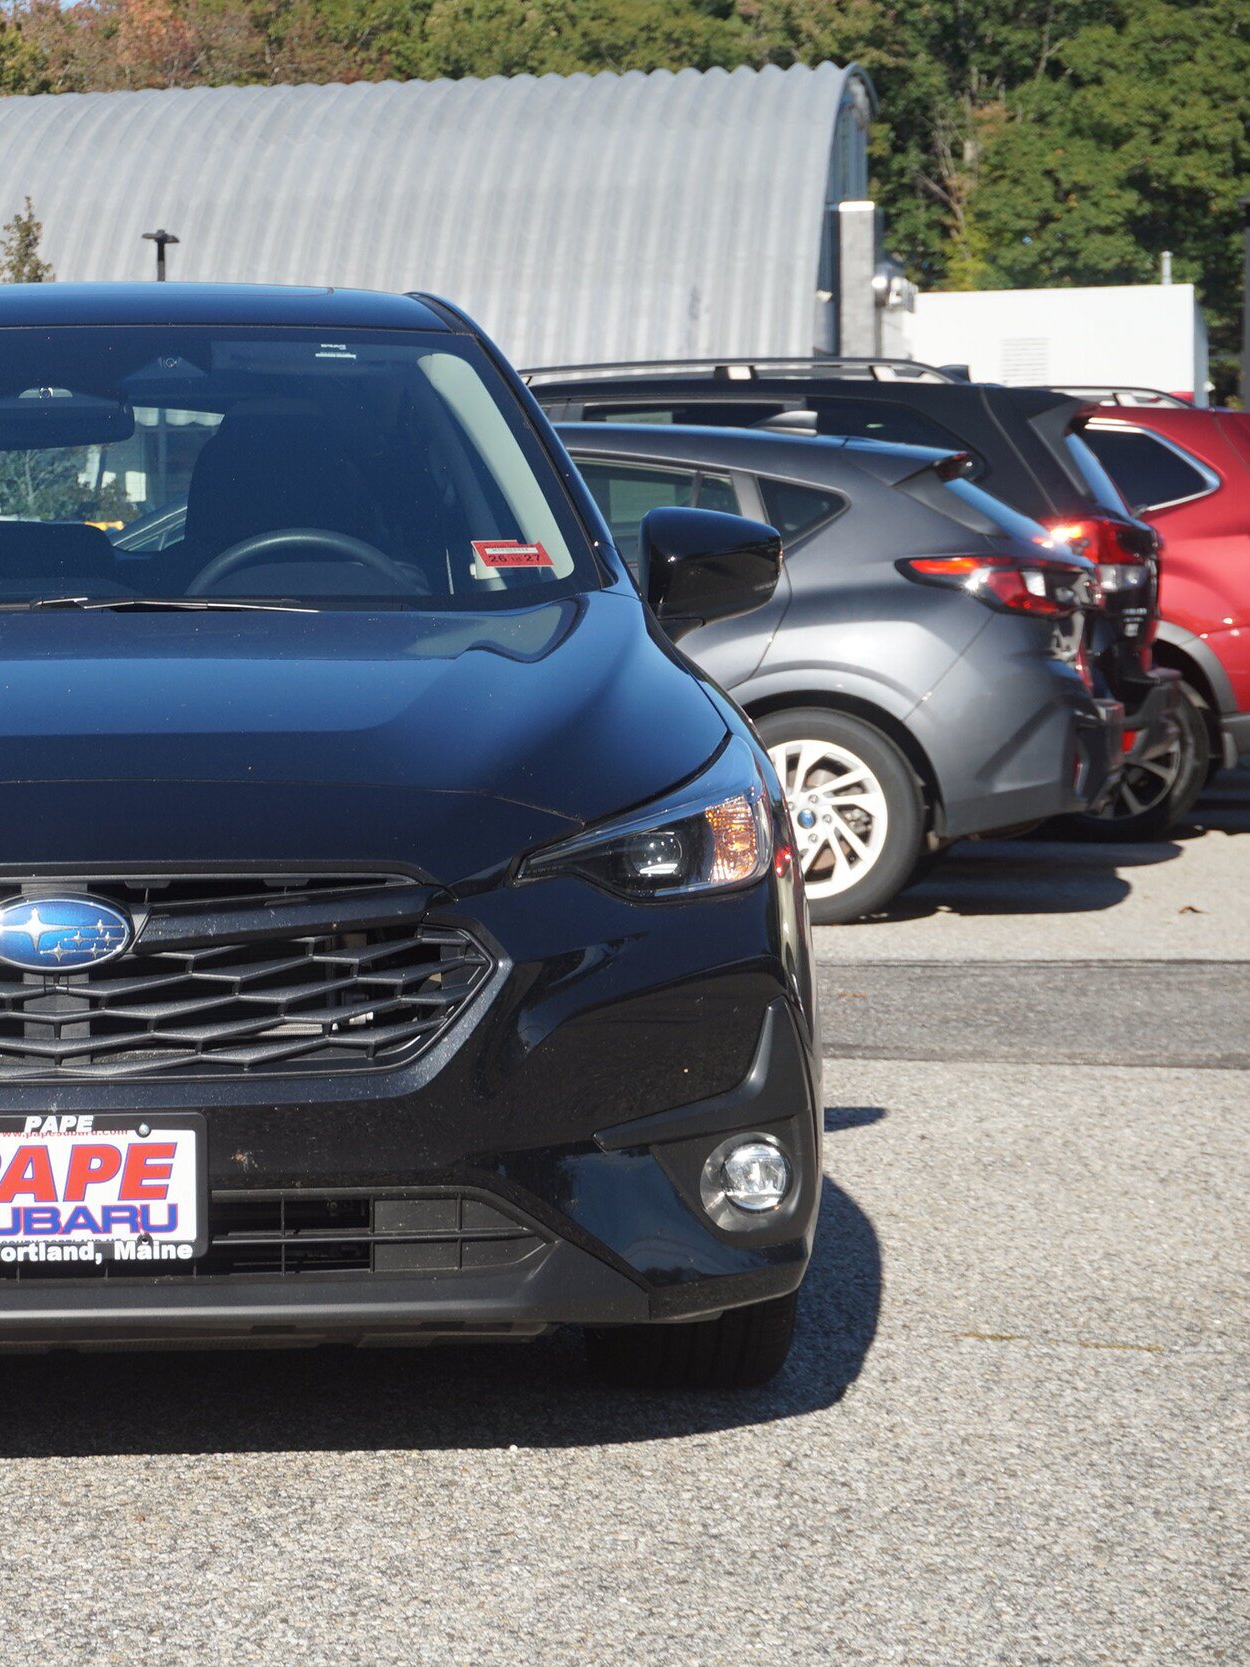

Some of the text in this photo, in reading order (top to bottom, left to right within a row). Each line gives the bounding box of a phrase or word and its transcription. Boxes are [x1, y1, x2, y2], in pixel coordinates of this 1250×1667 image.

[489, 554, 507, 562] 26
[524, 553, 540, 562] 27
[24, 1115, 94, 1133] PAPE
[114, 1237, 194, 1260] Maine
